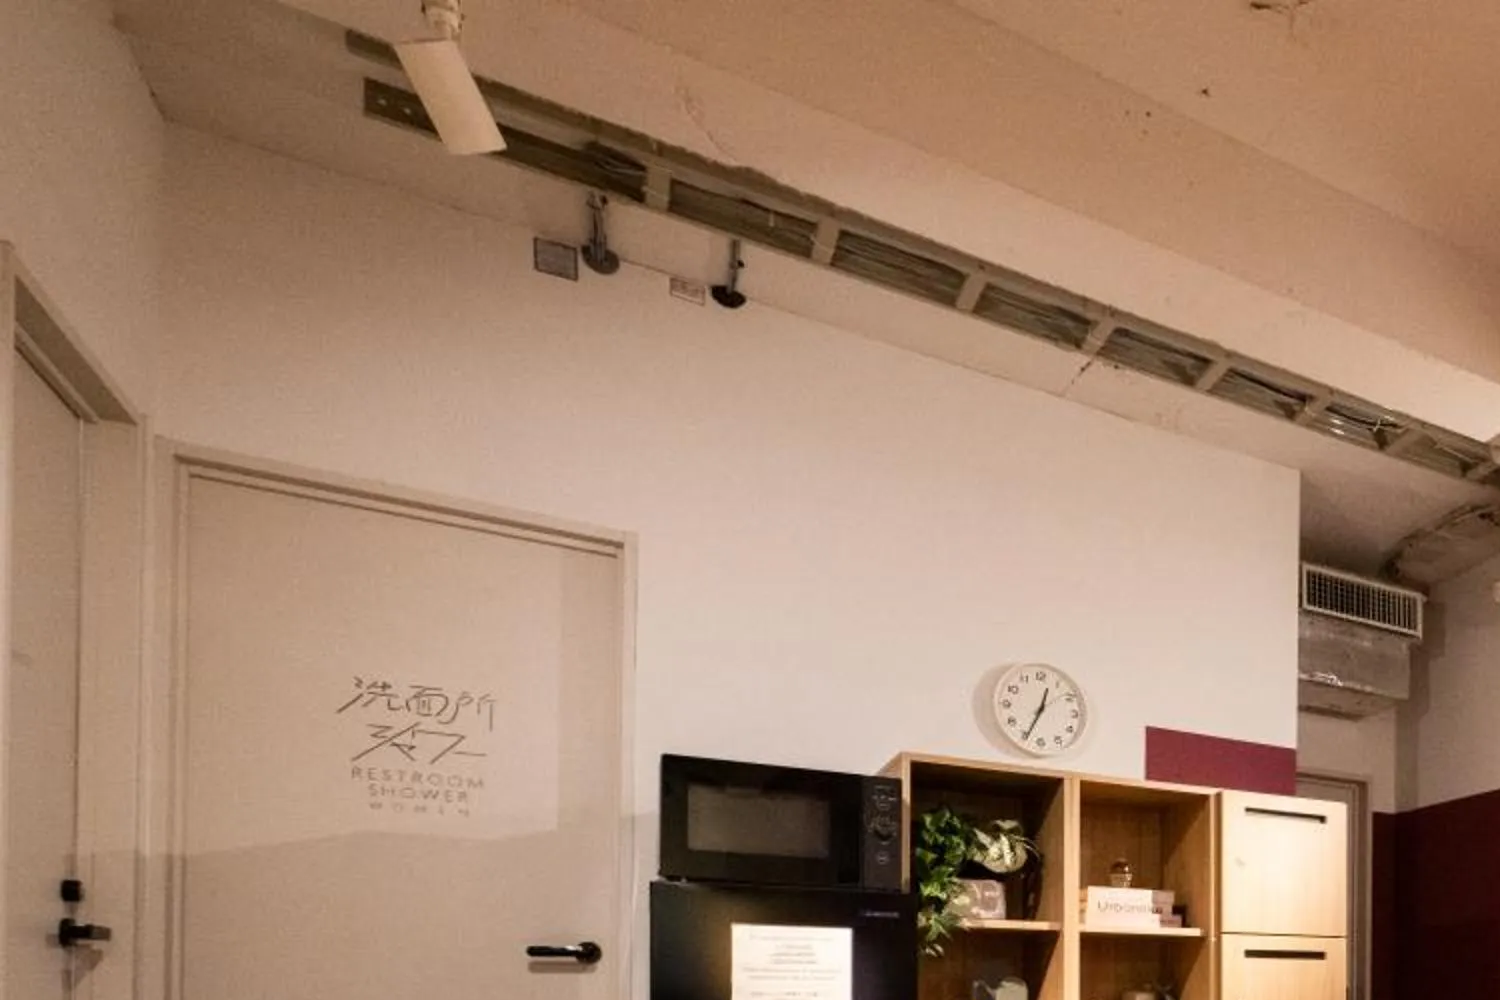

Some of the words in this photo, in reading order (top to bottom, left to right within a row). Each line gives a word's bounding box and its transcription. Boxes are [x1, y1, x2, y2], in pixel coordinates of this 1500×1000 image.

[1035, 671, 1046, 681] 12
[1007, 685, 1019, 695] 10
[351, 766, 484, 789] RESTROOM
[368, 783, 468, 803] SHOWER
